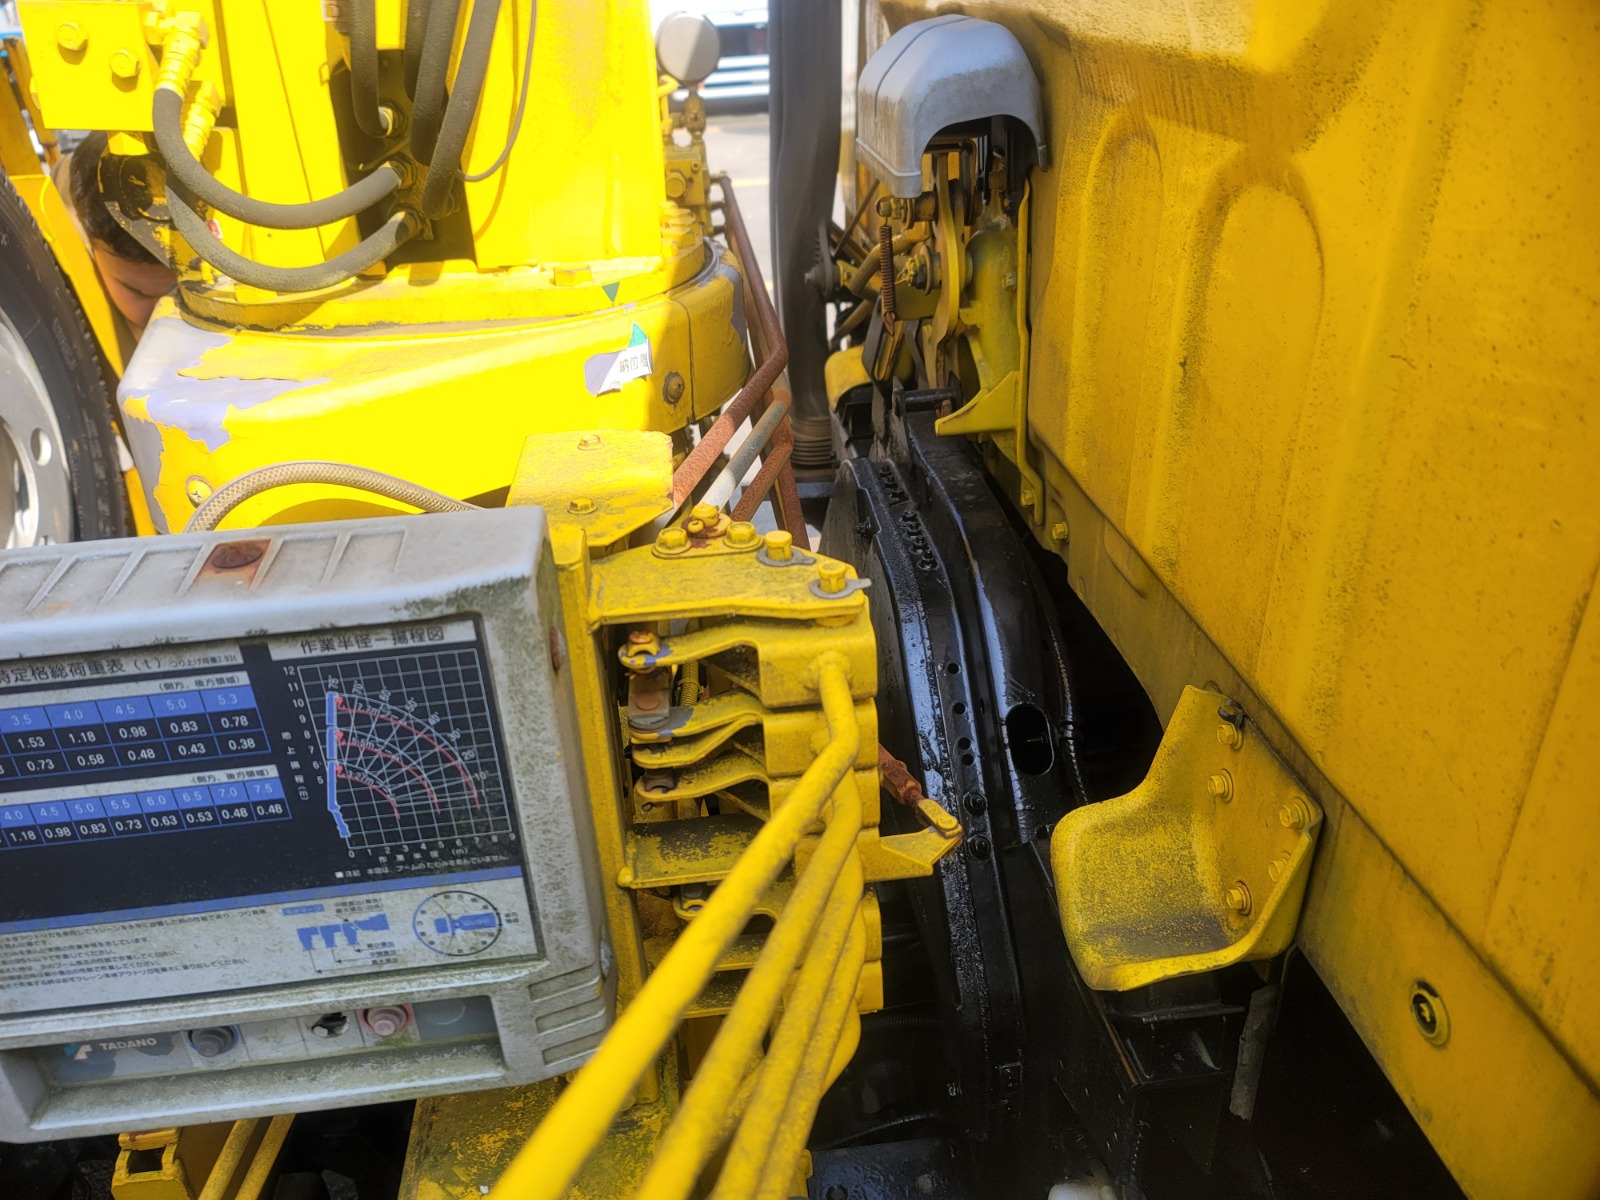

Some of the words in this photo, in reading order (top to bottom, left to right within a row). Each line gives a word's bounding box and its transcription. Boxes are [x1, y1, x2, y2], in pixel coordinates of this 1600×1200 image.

[283, 665, 295, 676] 12
[288, 682, 299, 692] 11
[293, 698, 304, 708] 10
[11, 713, 32, 726] 3.5
[64, 709, 83, 720] 4.0
[115, 703, 135, 715] 4.5
[166, 698, 187, 710] 5.0
[217, 692, 238, 705] 5.3
[299, 714, 306, 724] 9
[18, 736, 45, 749] 1.53
[69, 731, 96, 744] 1.18
[119, 726, 147, 739] 0.98
[170, 720, 198, 734] 0.83
[221, 715, 249, 728] 0.78
[303, 729, 311, 740] 8
[27, 758, 55, 772] 0.73
[77, 753, 104, 766] 0.58
[127, 748, 155, 761] 0.48
[178, 742, 206, 756] 0.43
[228, 737, 256, 751] 0.38
[307, 745, 314, 754] 7
[313, 760, 320, 770] 6
[317, 775, 324, 785] 5
[4, 810, 23, 820] 4.0
[40, 806, 59, 817] 4.5
[75, 803, 94, 814] 5.0
[110, 798, 130, 810] 5.5
[218, 787, 238, 798] 7.0
[253, 783, 273, 794] 7.5
[10, 830, 36, 842] 1.18
[44, 826, 71, 839] 0.98
[80, 822, 107, 835] 0.83
[115, 819, 142, 831] 0.73
[150, 814, 178, 828] 0.63
[186, 811, 213, 824] 0.53
[221, 807, 248, 820] 0.48
[256, 803, 283, 816] 0.48
[348, 850, 355, 858] 0
[367, 848, 372, 856] 1
[384, 846, 391, 854] 2
[402, 844, 409, 852] 3
[420, 842, 427, 850] 4
[438, 841, 445, 849] 5
[455, 838, 463, 847] 6
[473, 836, 480, 845] 7
[491, 834, 498, 843] 8
[509, 832, 516, 841] 9
[98, 1037, 157, 1051] TADANO
